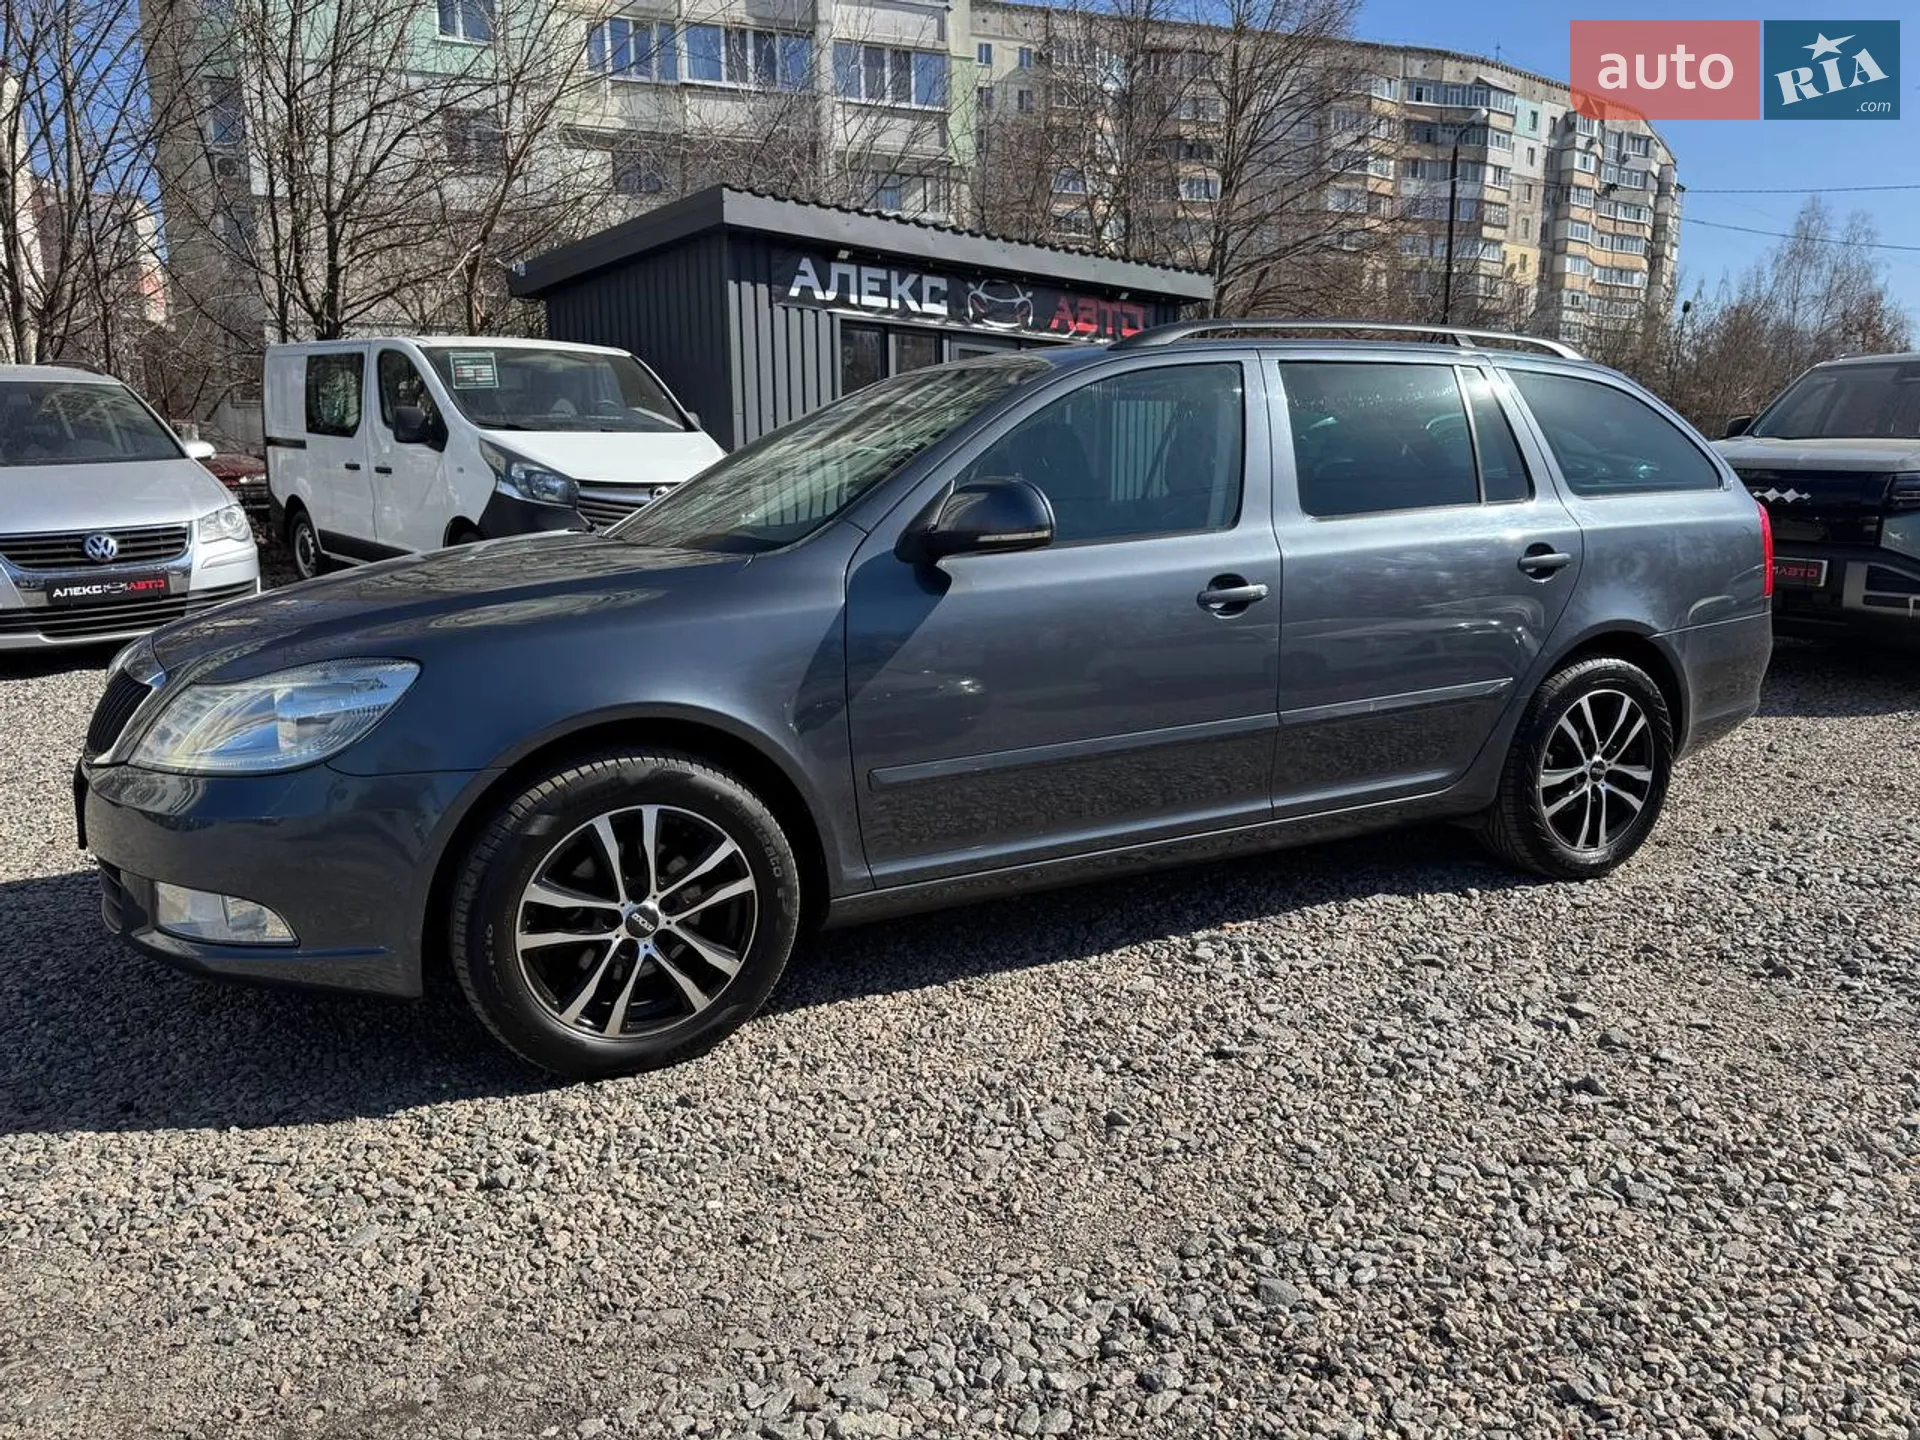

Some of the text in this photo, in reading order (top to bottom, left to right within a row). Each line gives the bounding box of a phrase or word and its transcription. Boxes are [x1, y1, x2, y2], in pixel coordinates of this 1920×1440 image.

[788, 256, 1145, 337] АЛЕКС АВТО
[53, 578, 165, 598] АЛЕКС АВТО
